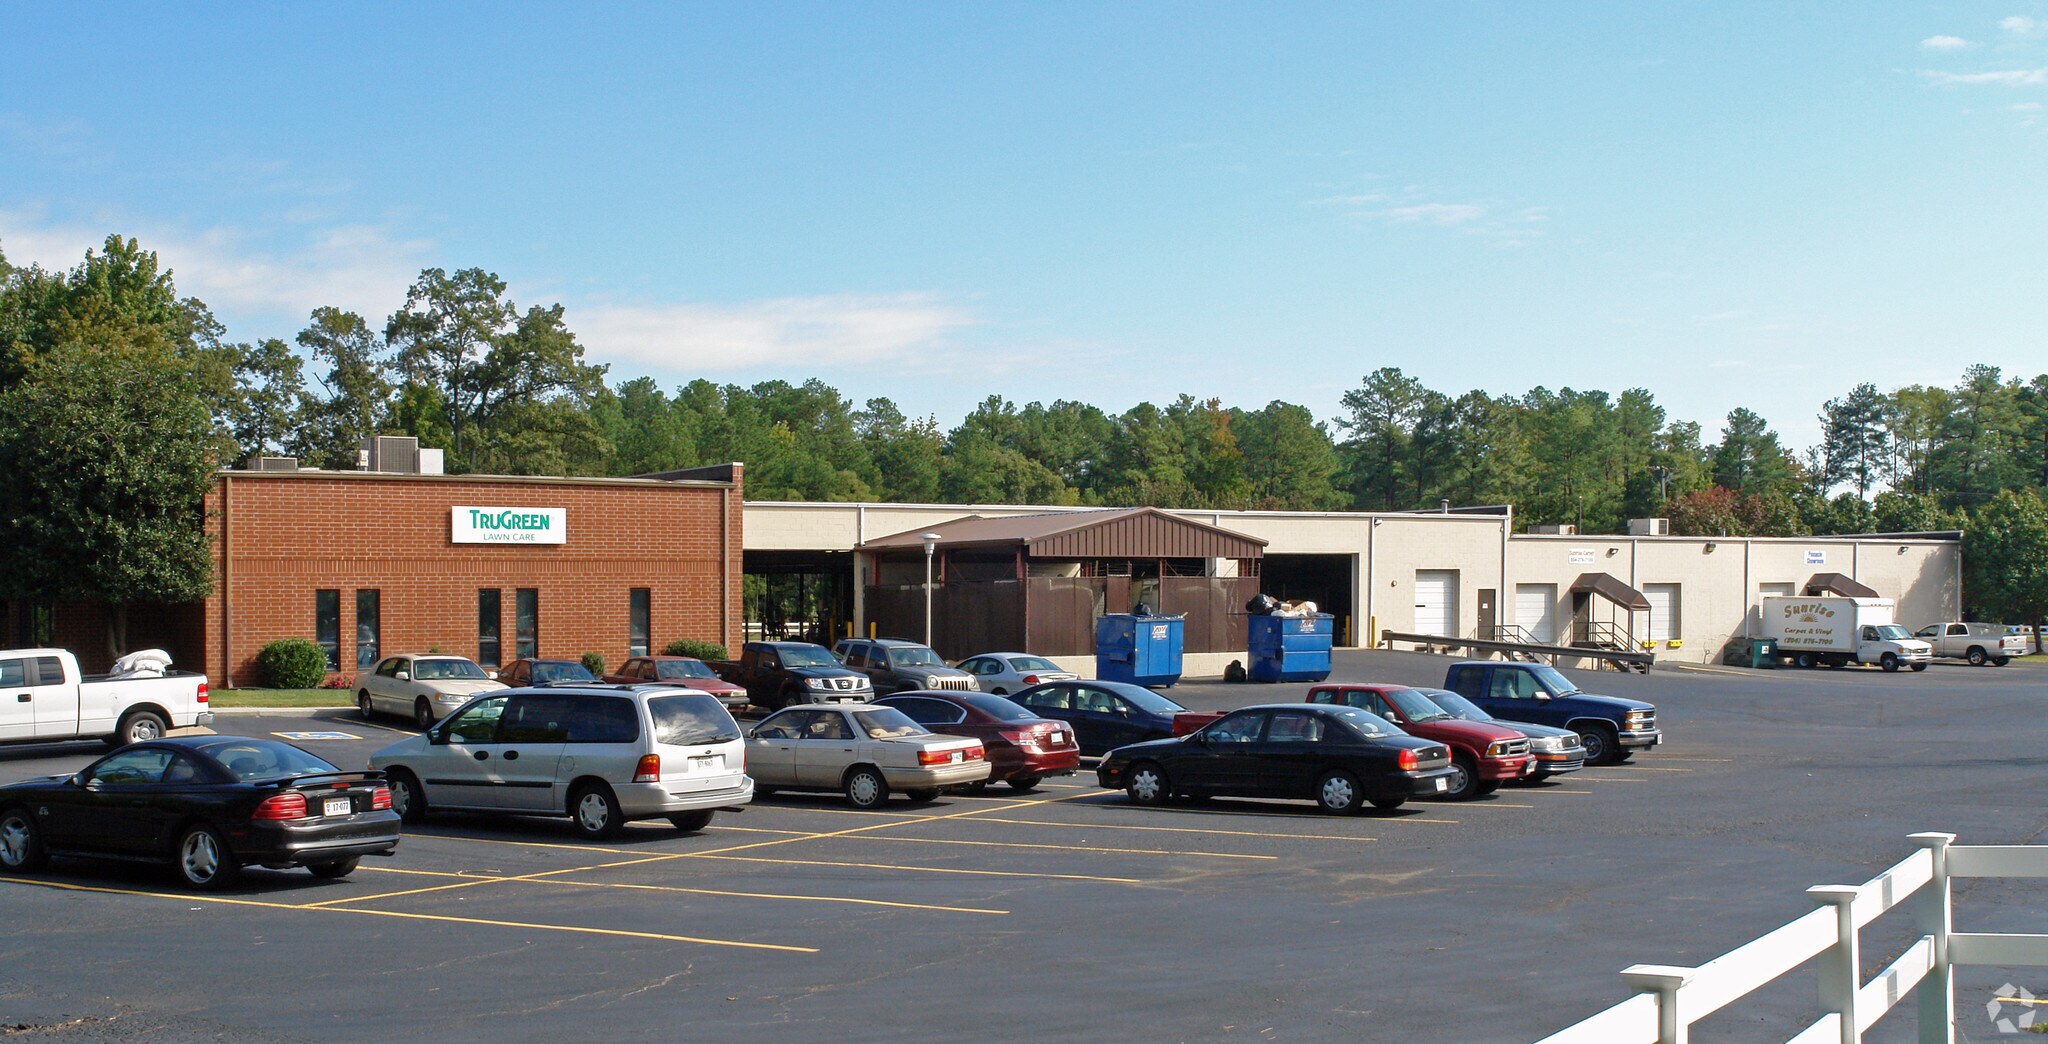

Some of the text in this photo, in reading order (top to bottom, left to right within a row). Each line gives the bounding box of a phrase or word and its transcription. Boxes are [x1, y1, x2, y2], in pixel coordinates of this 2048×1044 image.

[483, 533, 536, 541] LAWN CARE
[1784, 603, 1835, 618] Sunrise
[1784, 627, 1807, 635] Carpet
